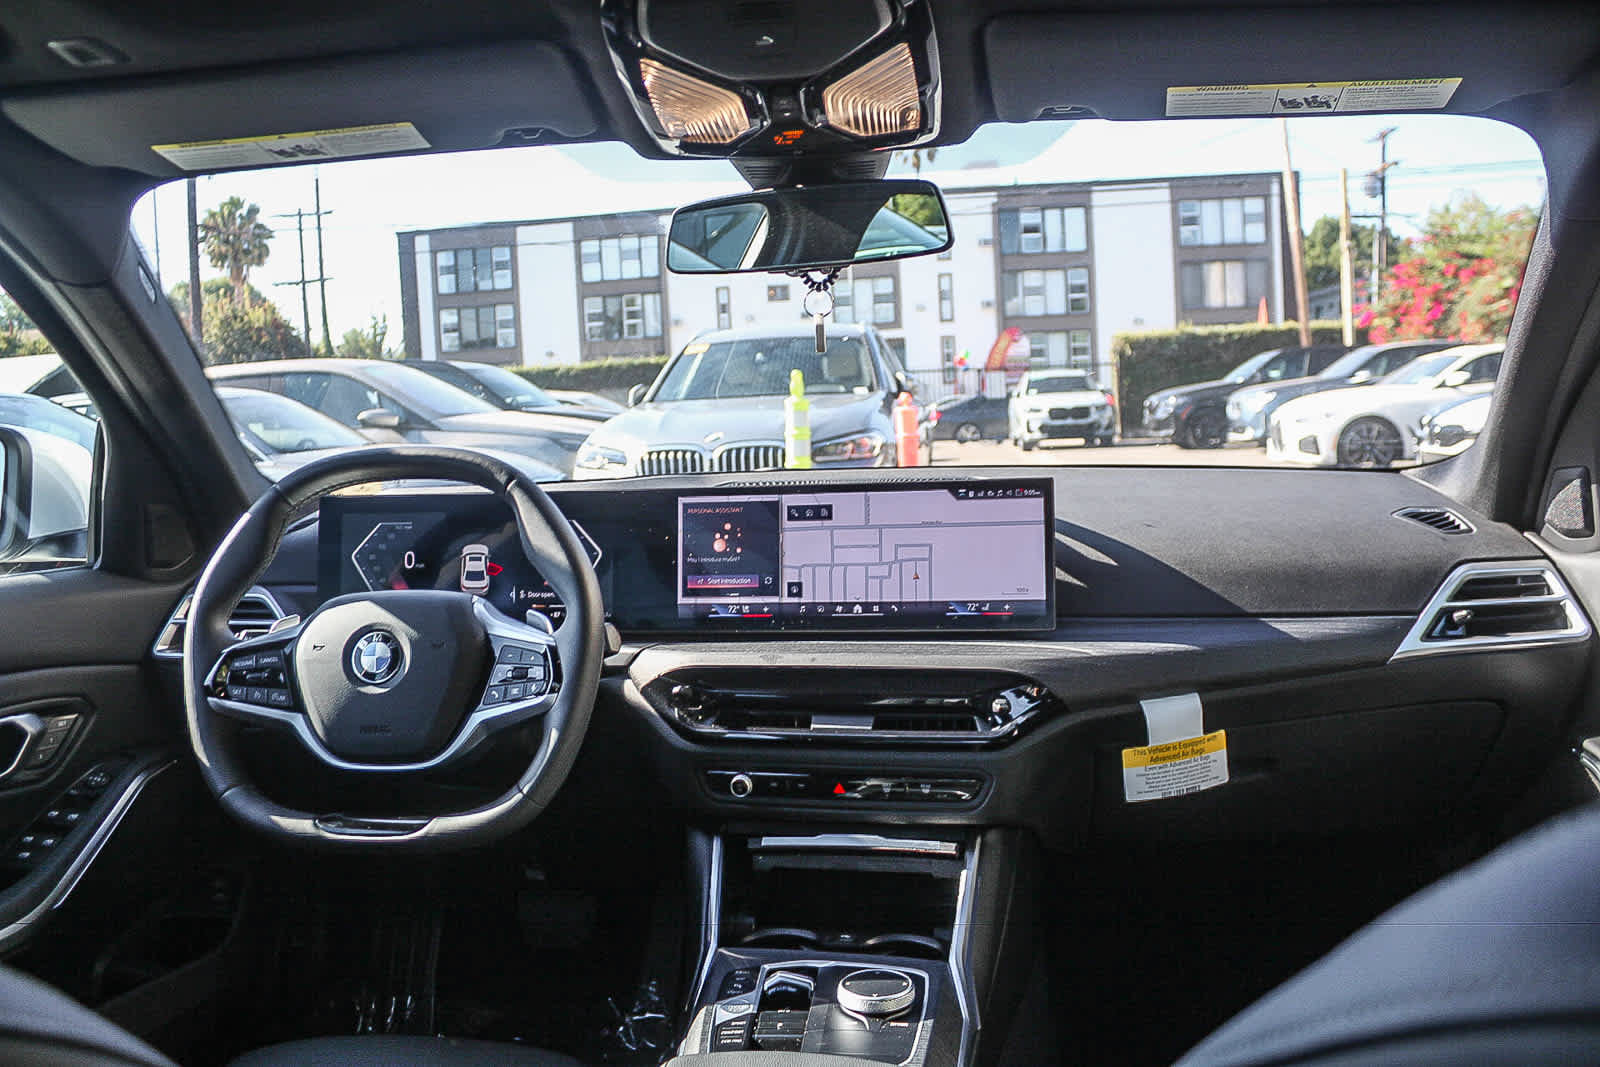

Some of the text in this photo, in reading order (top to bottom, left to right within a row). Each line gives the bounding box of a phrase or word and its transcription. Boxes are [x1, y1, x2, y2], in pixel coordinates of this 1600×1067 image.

[404, 551, 415, 570] 0
[1148, 743, 1170, 755] Vehicle
[1149, 752, 1182, 764] Advanced
